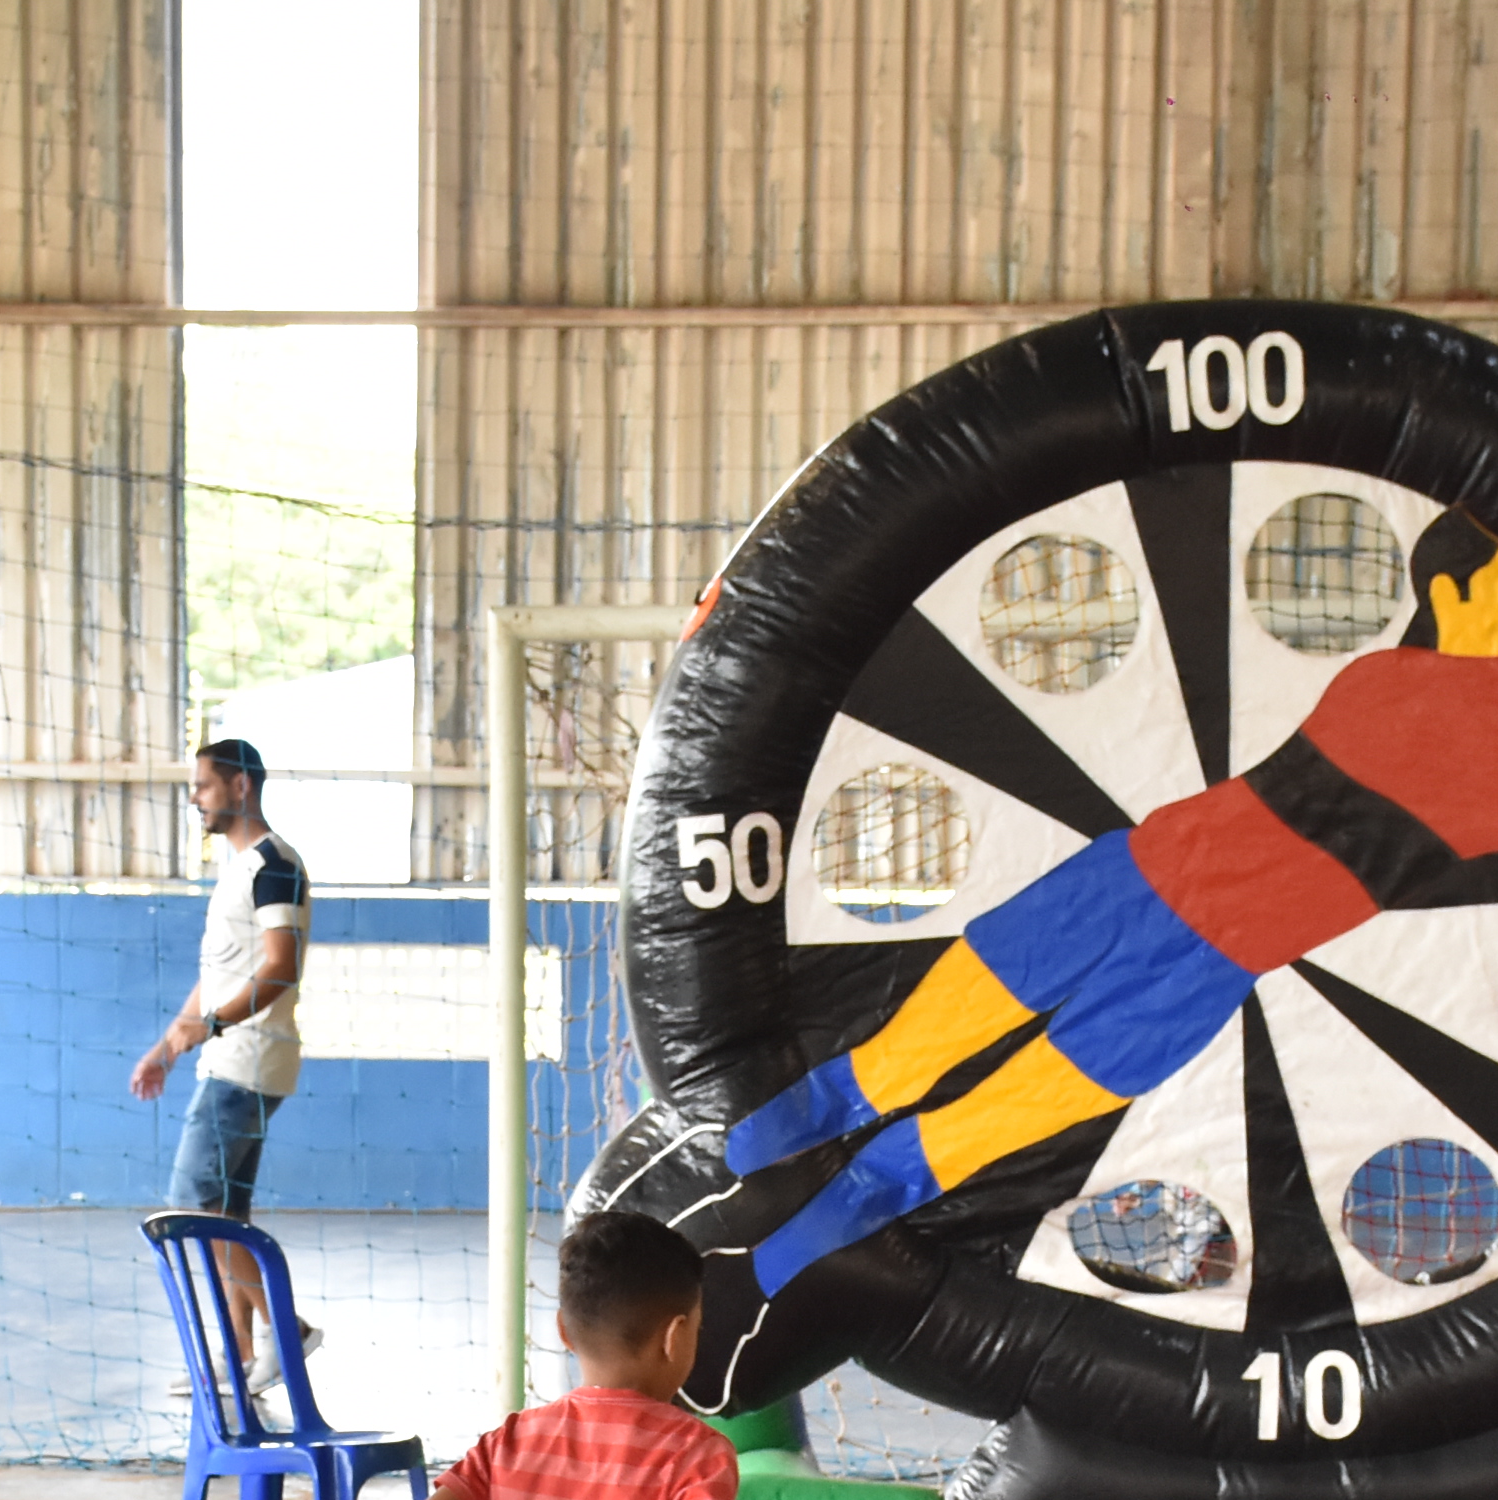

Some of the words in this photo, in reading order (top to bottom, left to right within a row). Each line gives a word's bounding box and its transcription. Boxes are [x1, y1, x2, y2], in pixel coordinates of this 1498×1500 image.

[1145, 331, 1305, 432] 100
[677, 812, 783, 909] 50
[1241, 1350, 1361, 1441] 10
